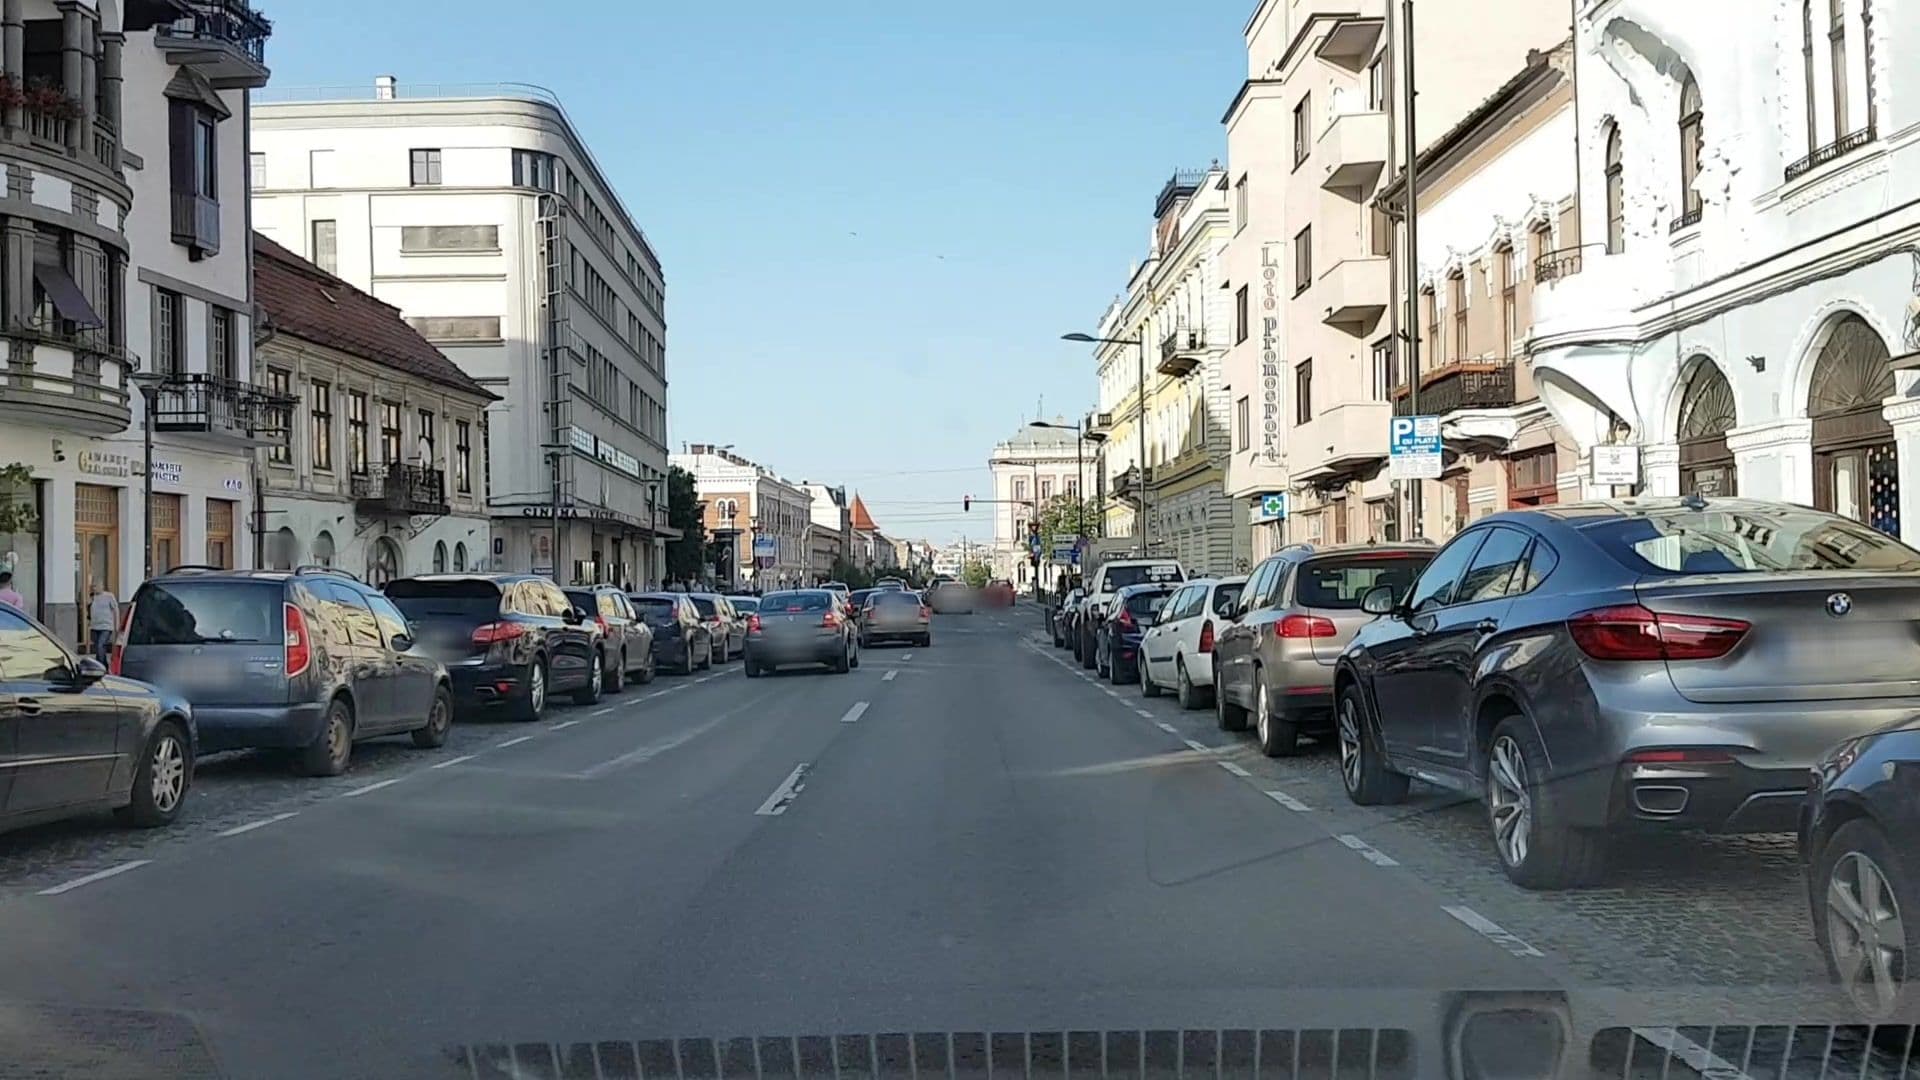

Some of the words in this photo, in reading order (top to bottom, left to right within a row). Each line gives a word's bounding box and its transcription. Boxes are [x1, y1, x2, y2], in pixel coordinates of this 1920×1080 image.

[1261, 247, 1279, 311] Loto
[1393, 419, 1413, 445] P
[523, 507, 578, 519] CINMA
